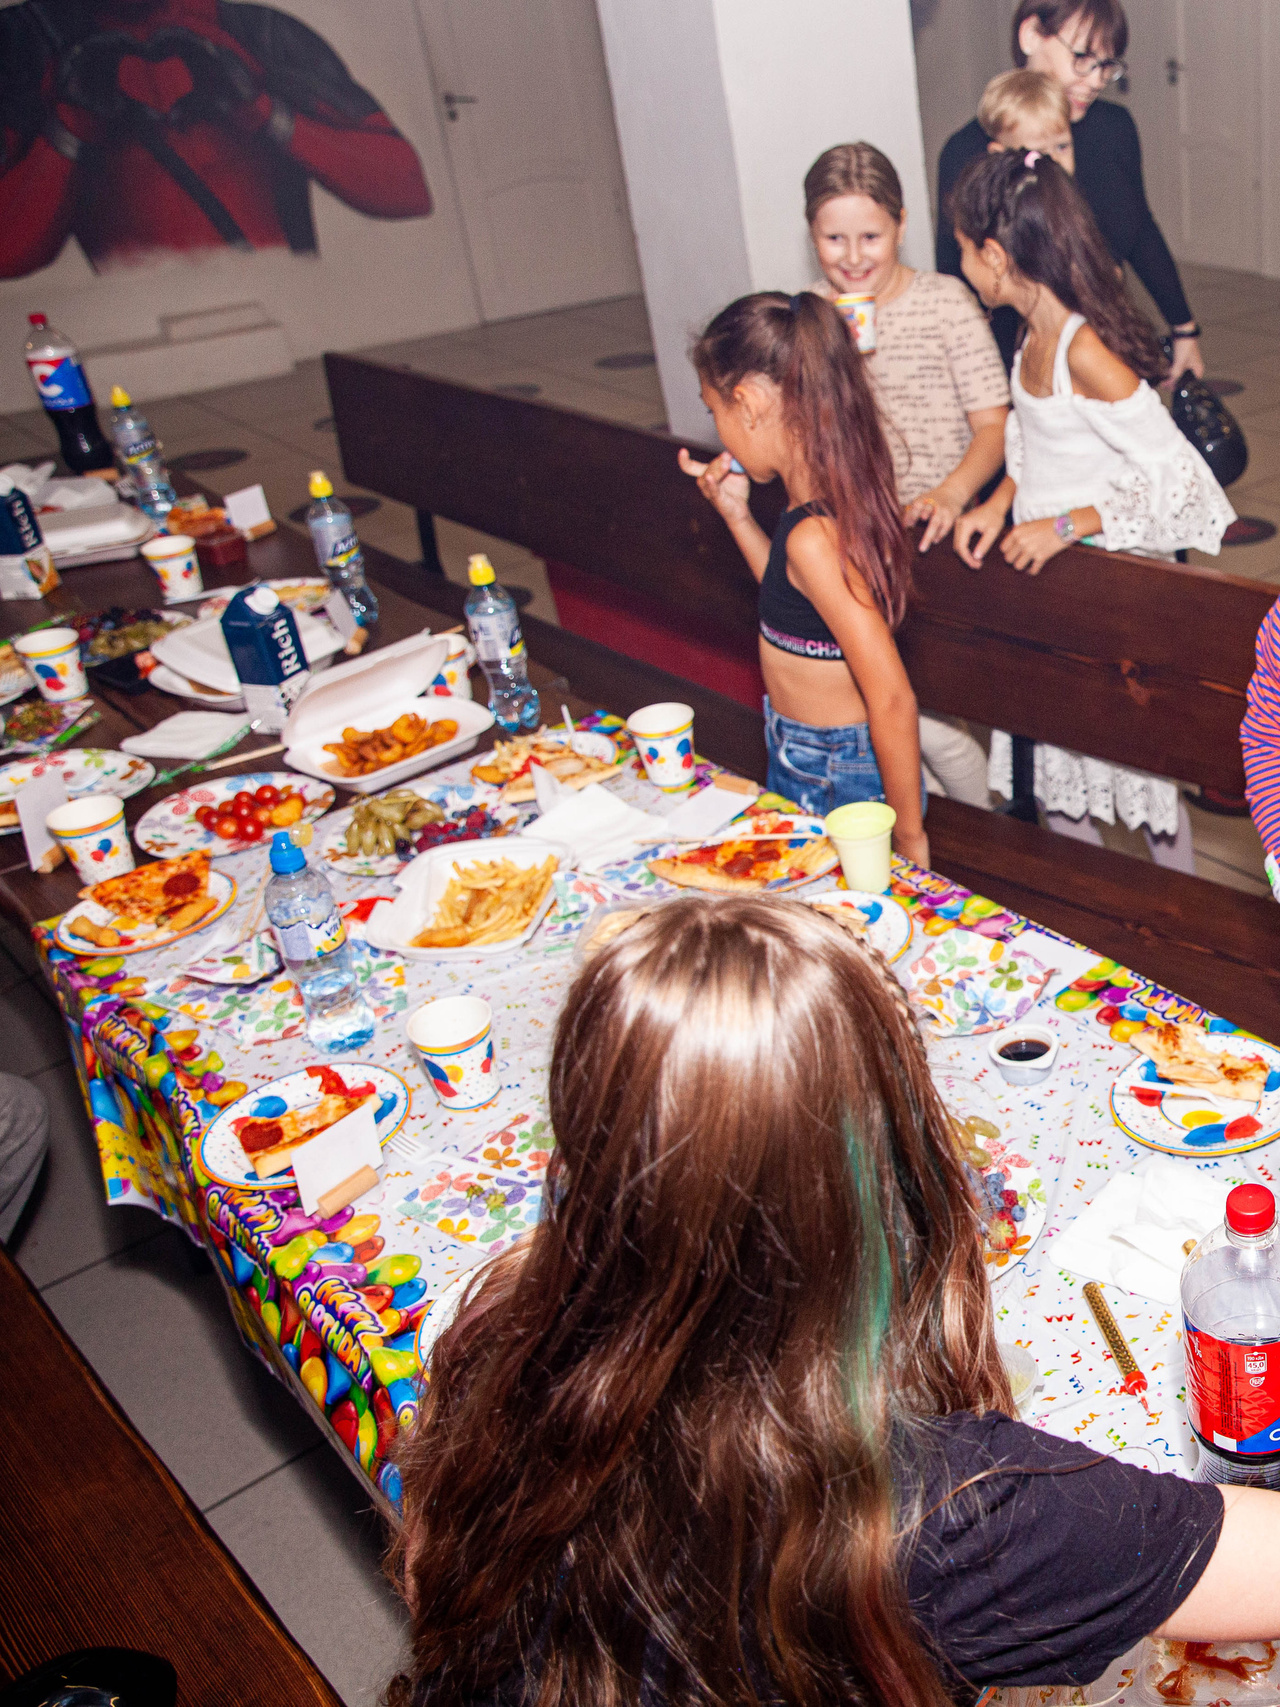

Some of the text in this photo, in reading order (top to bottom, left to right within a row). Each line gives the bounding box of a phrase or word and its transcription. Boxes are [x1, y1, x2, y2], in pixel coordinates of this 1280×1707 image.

[271, 617, 302, 677] Rich
[1130, 985, 1203, 1023] HAPPY
[298, 1289, 369, 1381] BIRTHDAY
[316, 1278, 380, 1338] HAPPY
